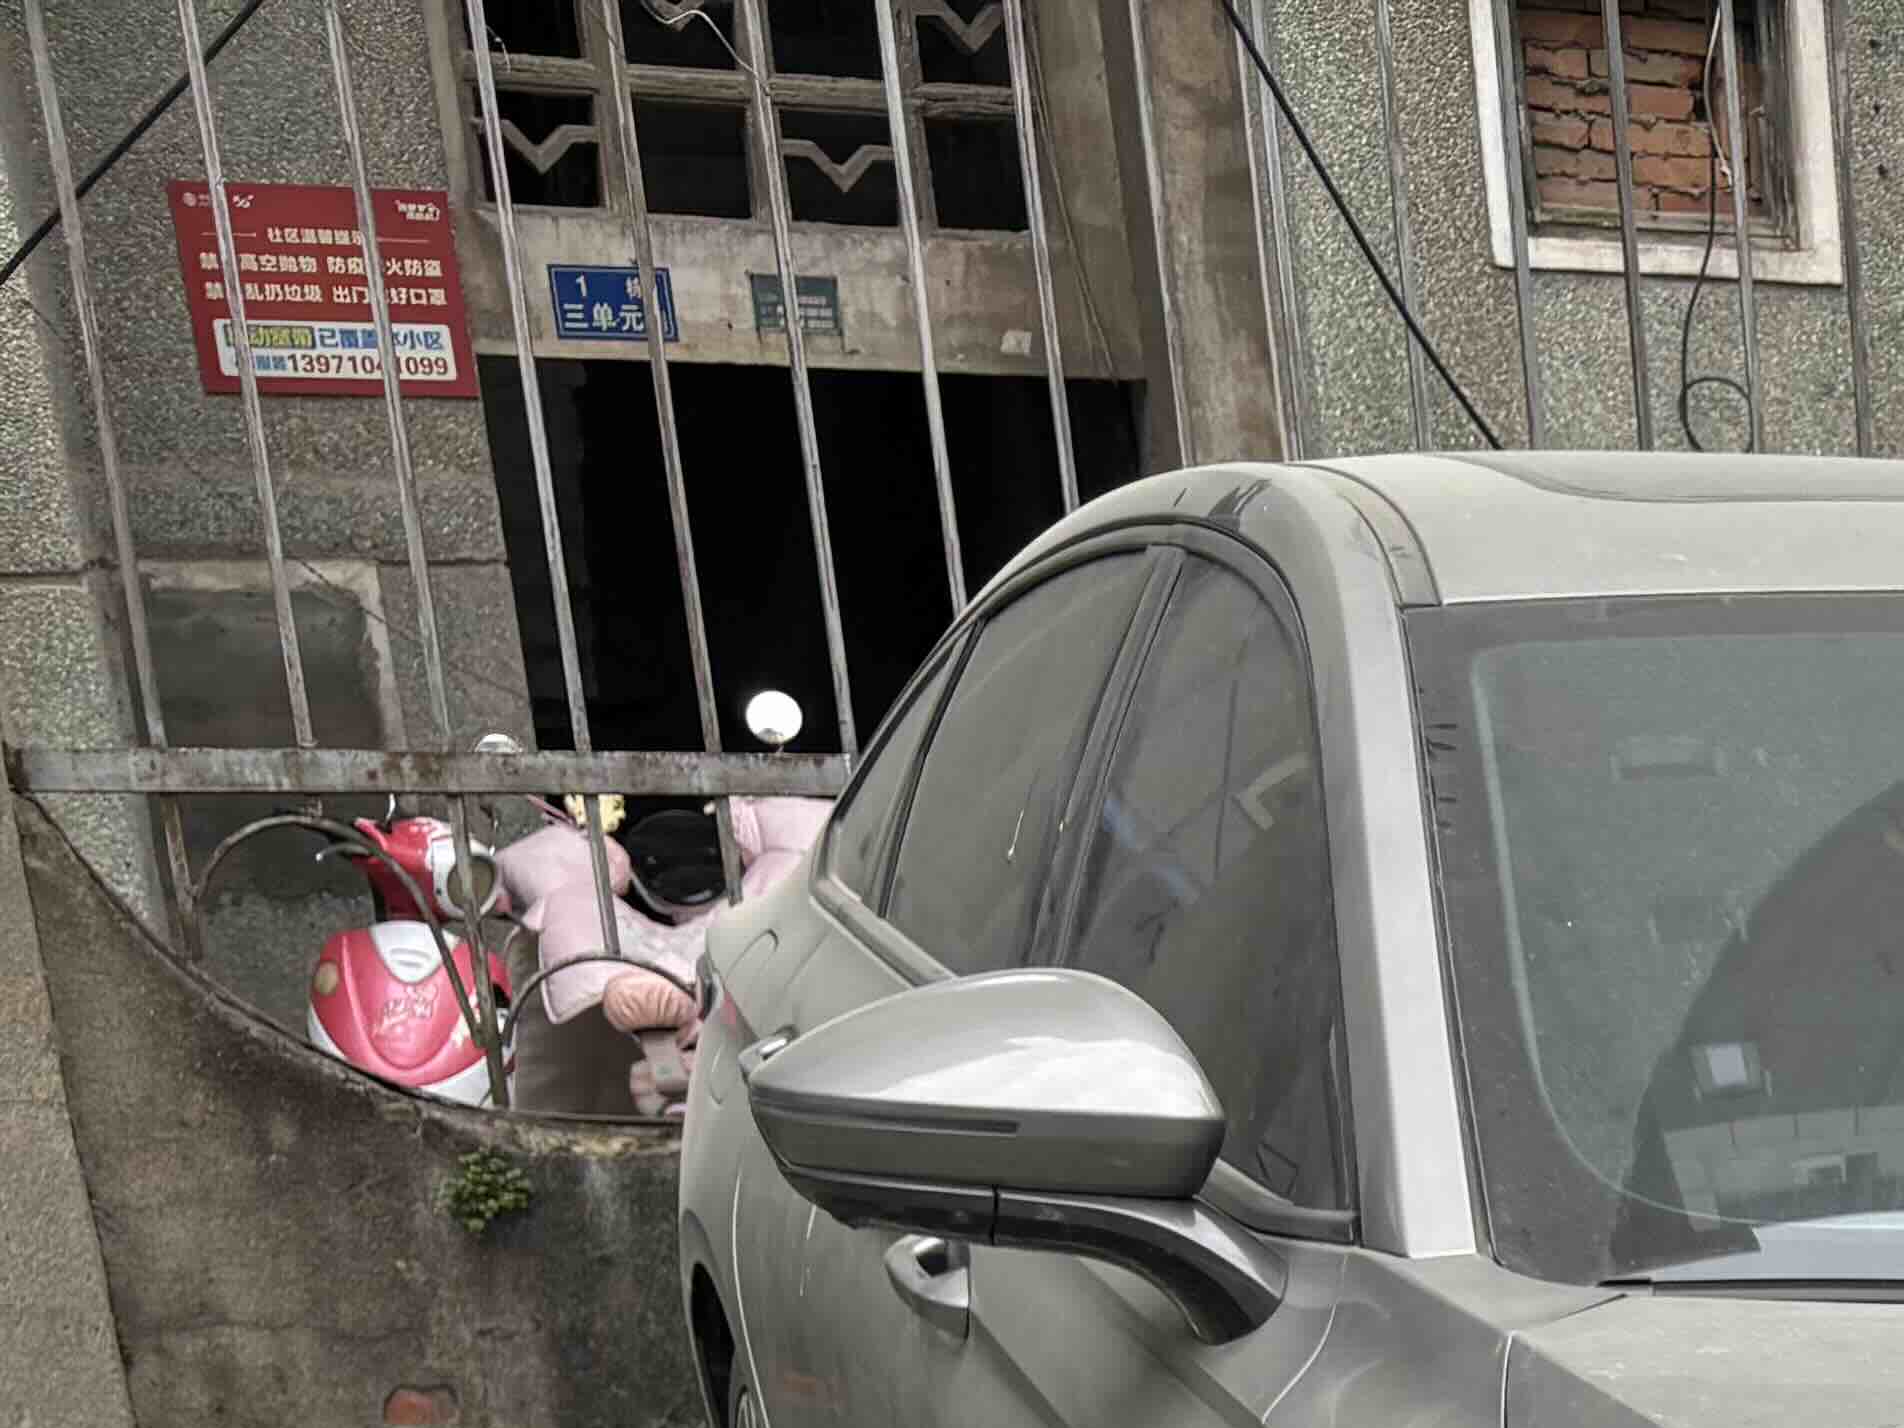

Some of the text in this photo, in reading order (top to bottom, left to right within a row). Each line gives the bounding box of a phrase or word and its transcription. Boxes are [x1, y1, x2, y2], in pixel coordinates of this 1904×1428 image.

[326, 255, 443, 277] 防疫火防盗
[205, 281, 447, 306] 禁乱扔垃圾 出门好口罩
[575, 274, 588, 297] 1
